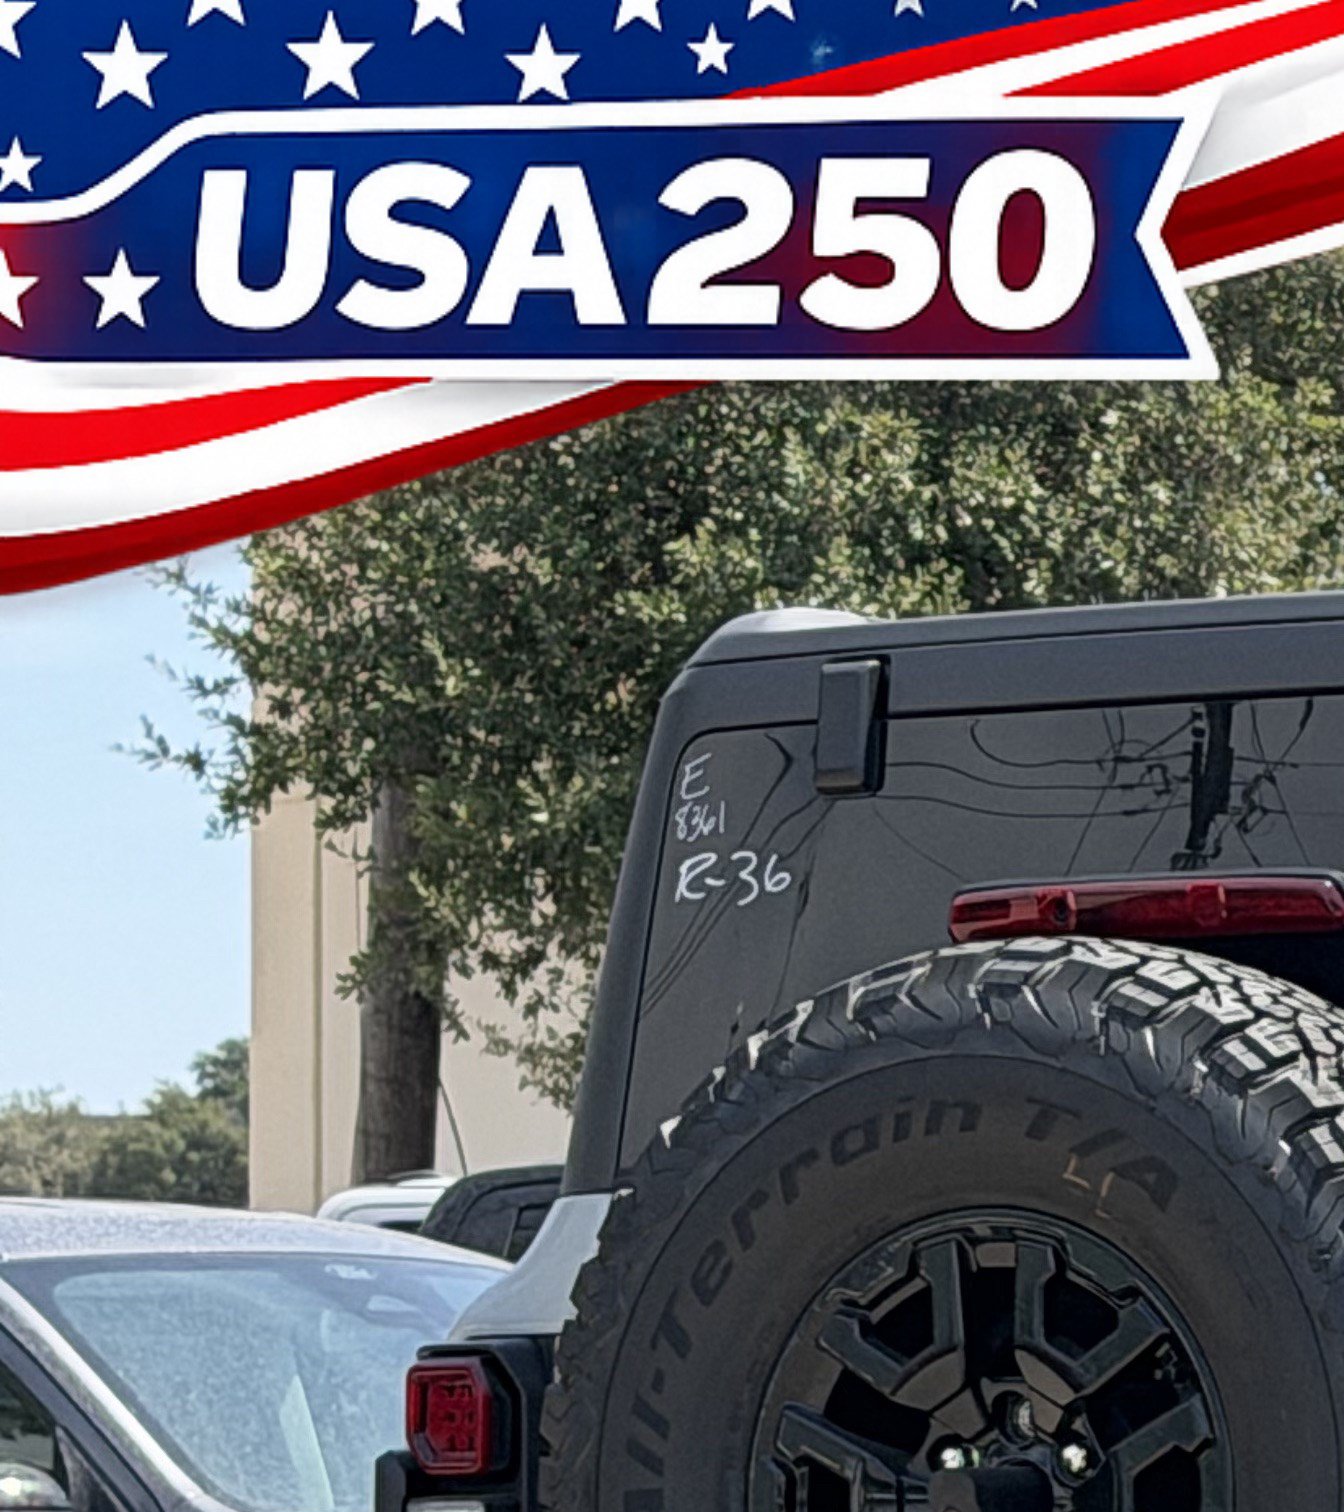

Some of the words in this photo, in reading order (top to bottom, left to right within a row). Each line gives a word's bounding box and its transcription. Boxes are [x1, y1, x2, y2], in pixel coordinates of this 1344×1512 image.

[680, 752, 712, 800] E
[674, 850, 792, 906] R-36
[1023, 1098, 1180, 1214] T/A
